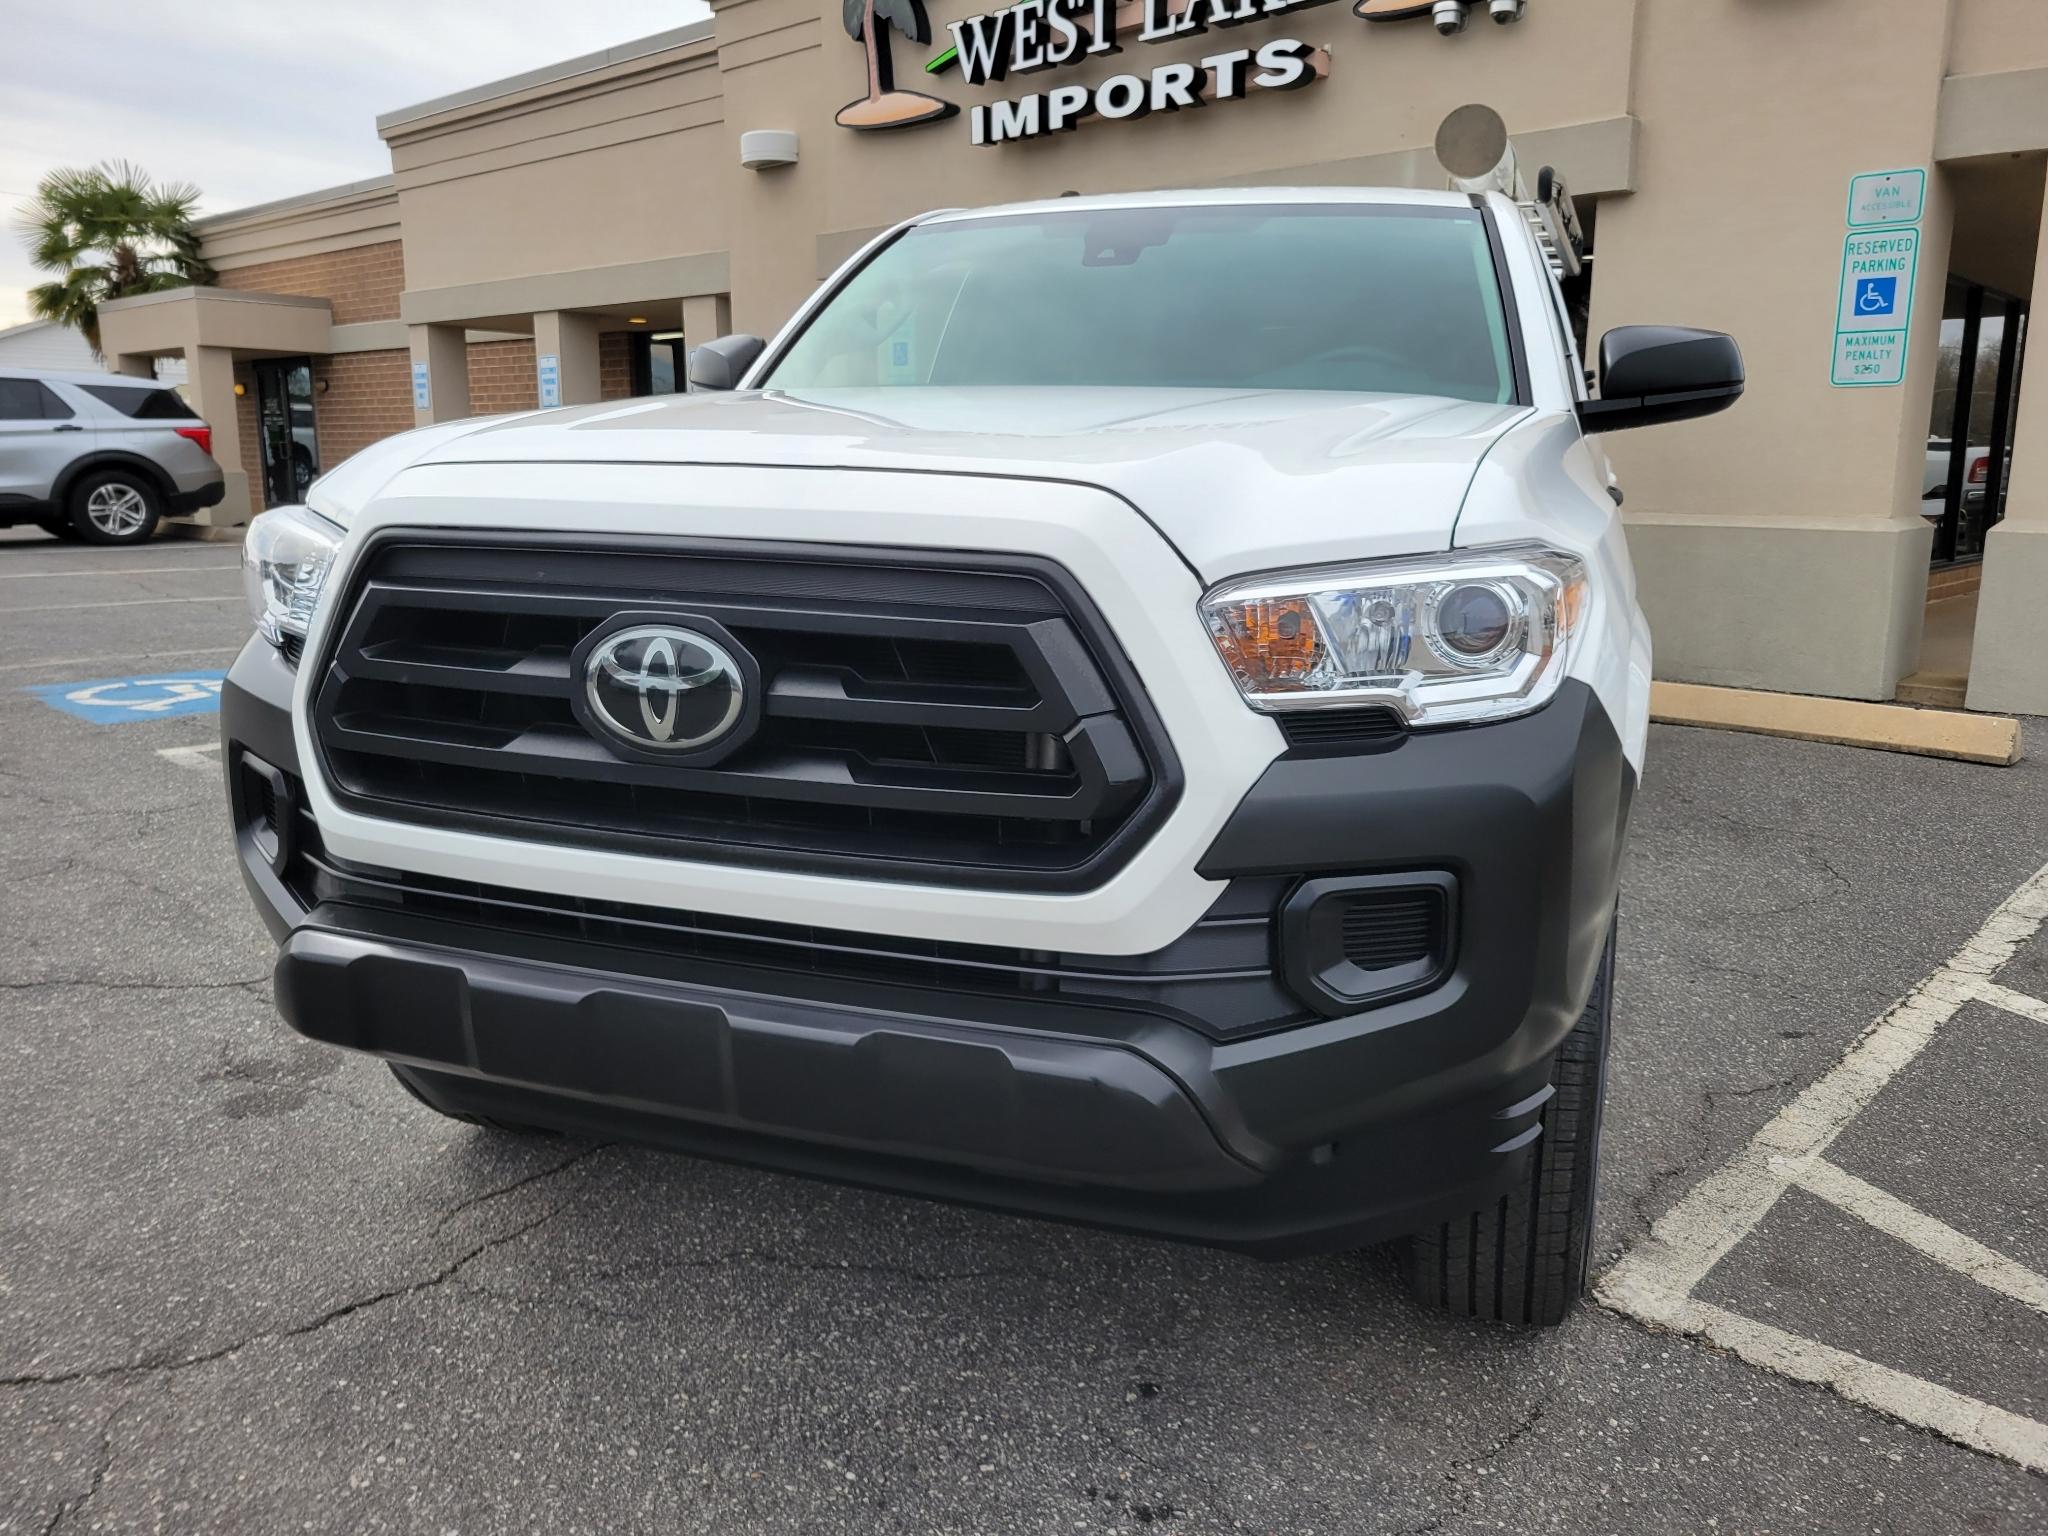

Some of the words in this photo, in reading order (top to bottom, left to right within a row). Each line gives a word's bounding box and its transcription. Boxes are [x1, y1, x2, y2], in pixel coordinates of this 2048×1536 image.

[946, 0, 1111, 84] WEST
[970, 38, 1305, 145] IMPORTS
[1875, 185, 1901, 198] VAN
[1848, 238, 1913, 256] RESERVED
[1852, 257, 1906, 273] PARKING
[1845, 335, 1895, 347] MAXIMUM
[1845, 349, 1892, 361] PENALTY
